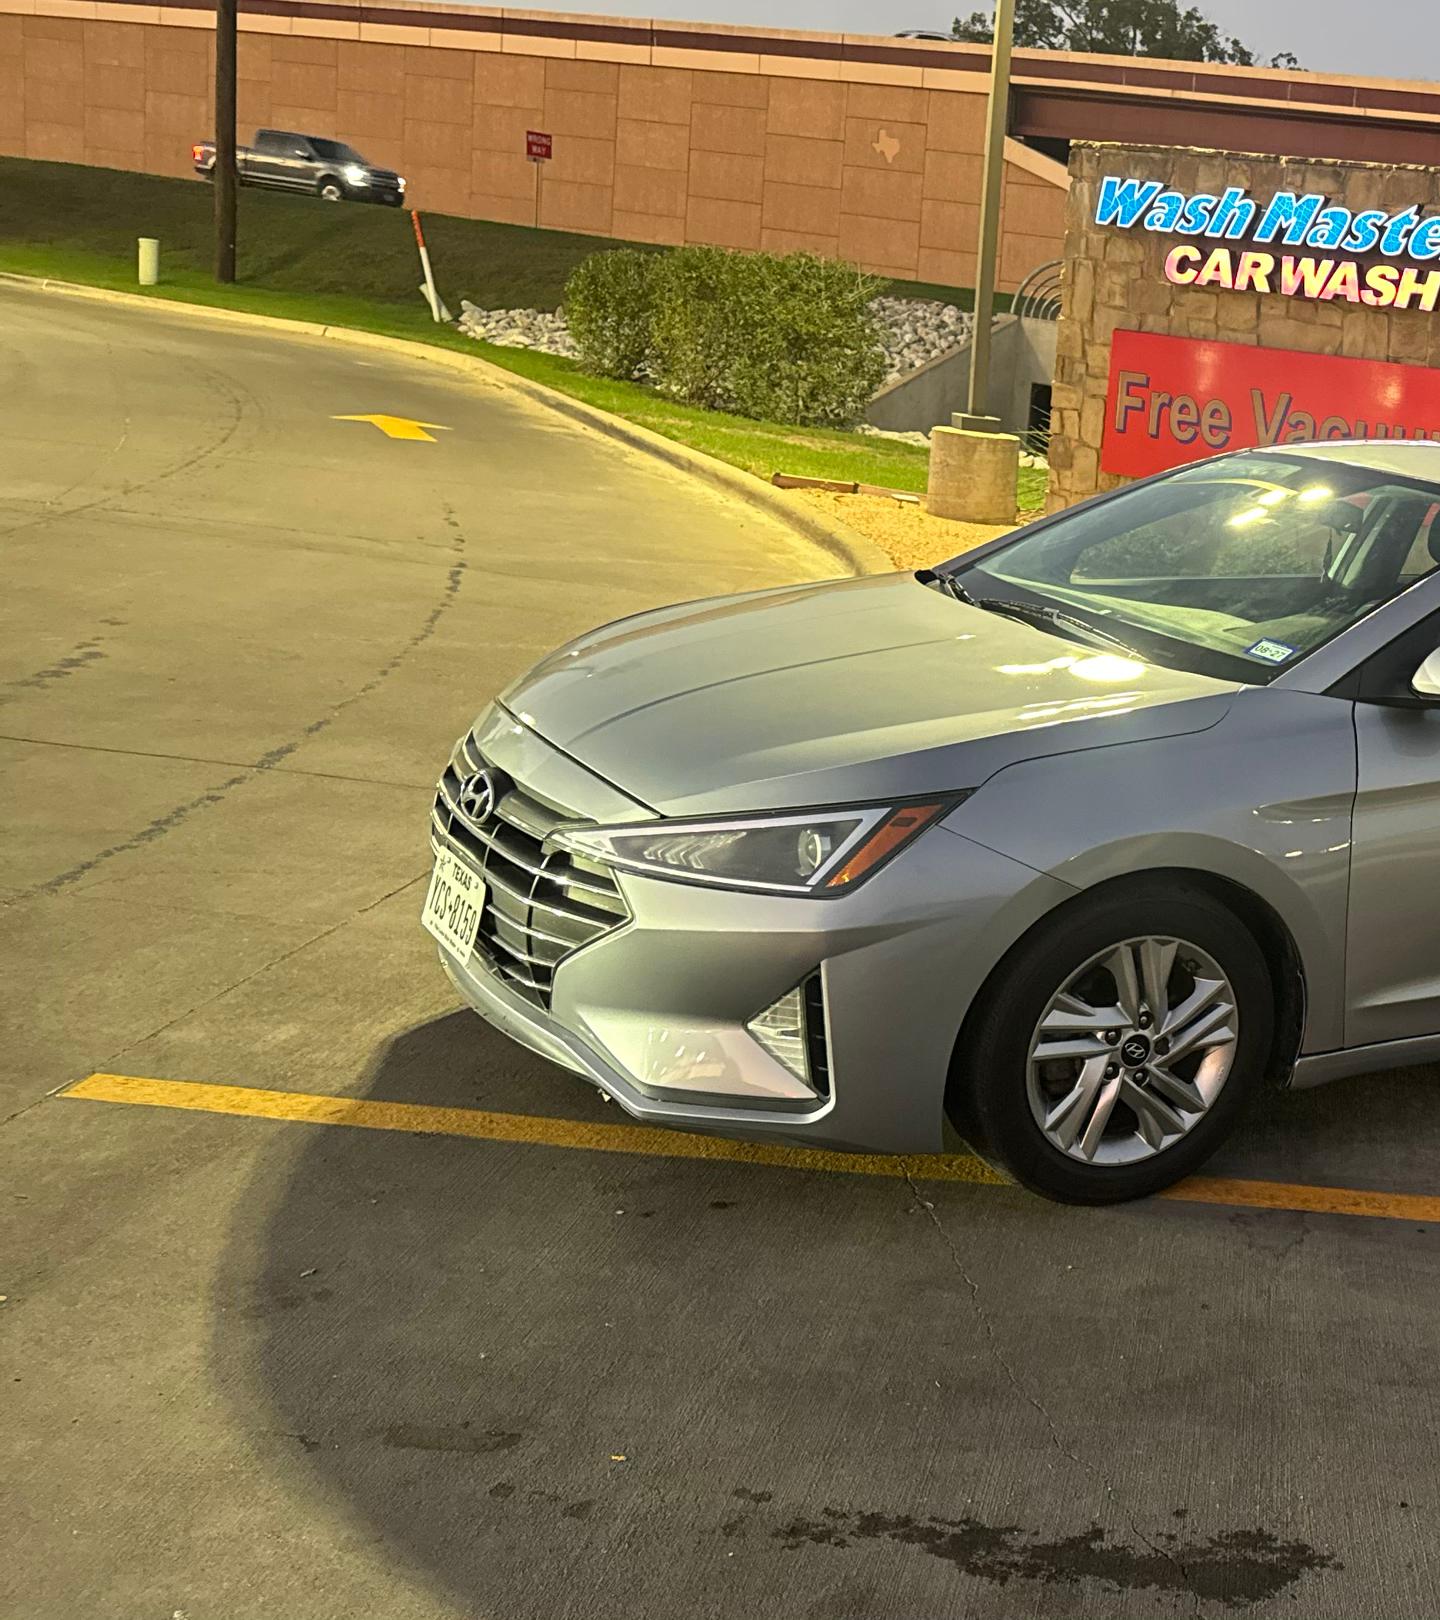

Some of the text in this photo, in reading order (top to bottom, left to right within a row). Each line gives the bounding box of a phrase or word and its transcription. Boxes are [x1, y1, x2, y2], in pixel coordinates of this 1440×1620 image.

[1095, 176, 1255, 239] Wash
[1165, 246, 1275, 293] CAR
[1115, 370, 1232, 449] Free
[452, 862, 473, 891] TEXAS
